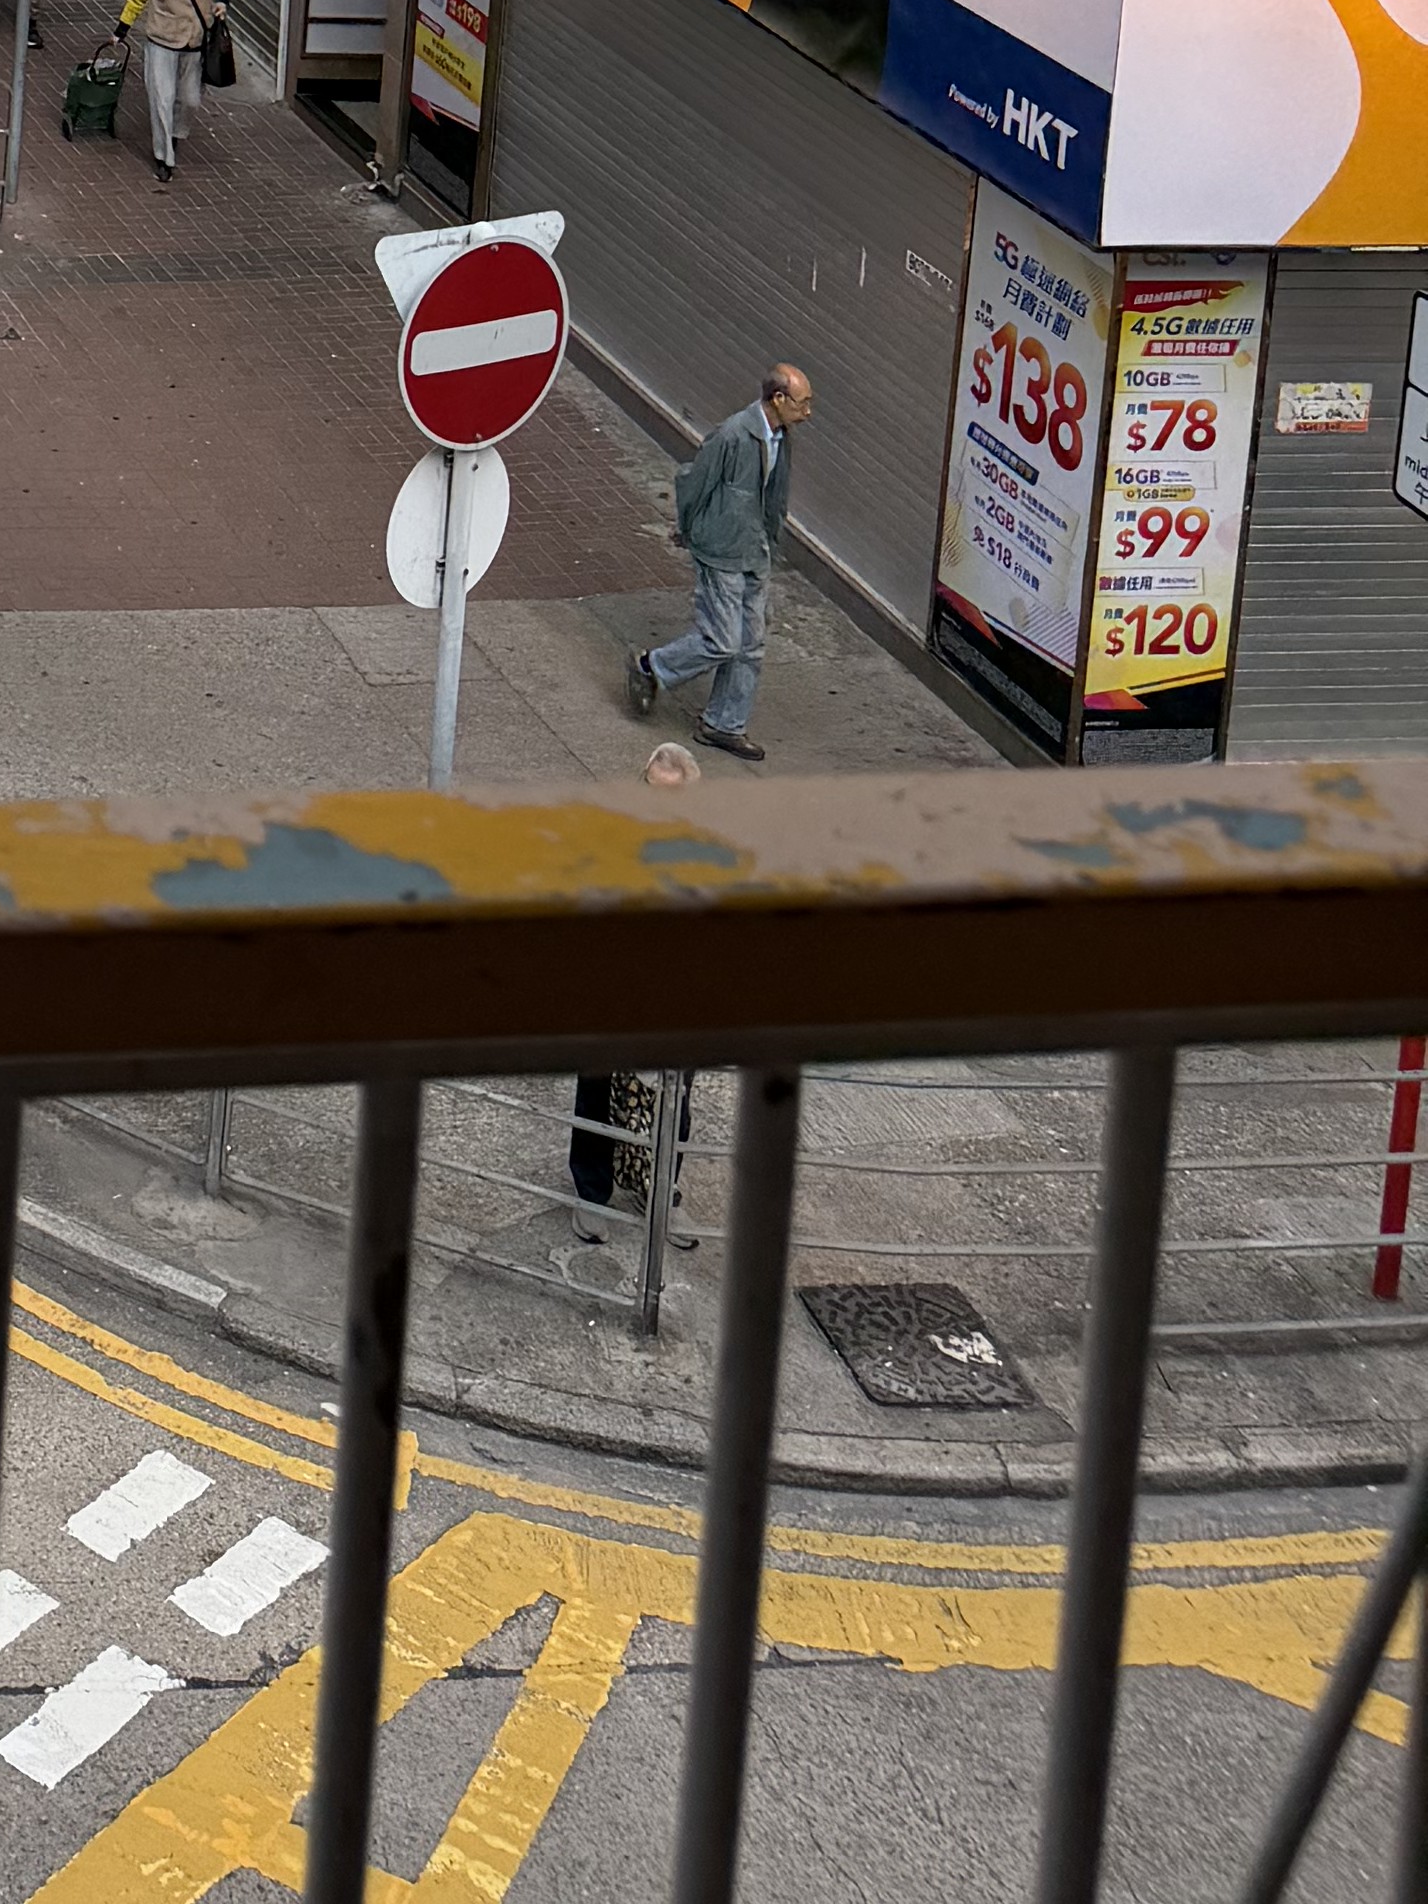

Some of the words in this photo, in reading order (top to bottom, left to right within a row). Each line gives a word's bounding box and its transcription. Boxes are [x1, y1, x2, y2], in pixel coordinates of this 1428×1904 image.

[948, 84, 986, 119] Powered
[986, 104, 999, 130] by
[1002, 88, 1079, 171] HKT
[994, 231, 1019, 270] 5G
[1020, 254, 1090, 318] 極速網絡
[1003, 277, 1072, 341] 月費計劃
[1130, 317, 1184, 335] 4.5G
[1185, 318, 1255, 335] 數據任用
[970, 320, 1088, 472] $138
[1123, 370, 1171, 386] 10GB
[1126, 398, 1218, 453] $78
[981, 456, 1019, 500] 30GB
[1114, 467, 1161, 485] 16GB
[1137, 489, 1160, 500] 1GB
[986, 495, 1015, 533] 2GB
[1114, 505, 1211, 560] $99
[987, 536, 1012, 569] $18
[1099, 576, 1153, 591] 數據任用
[1105, 602, 1218, 657] $120
